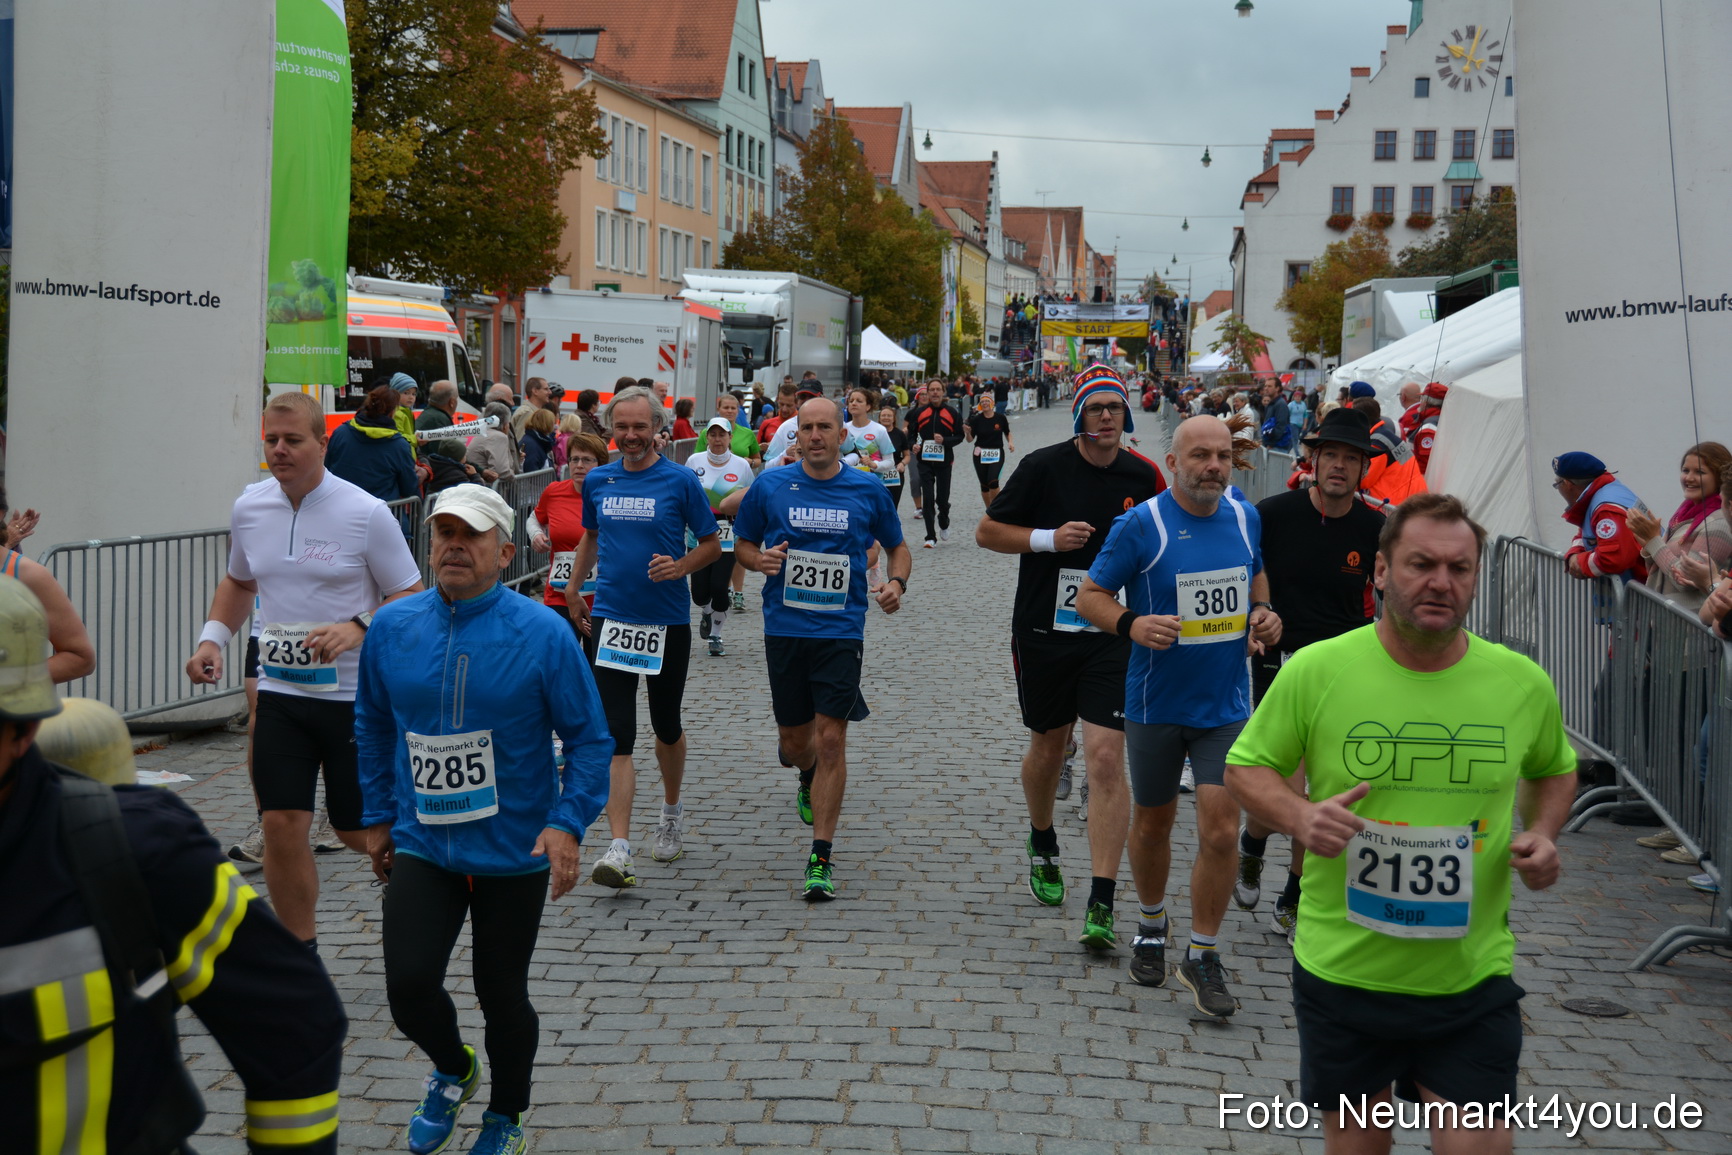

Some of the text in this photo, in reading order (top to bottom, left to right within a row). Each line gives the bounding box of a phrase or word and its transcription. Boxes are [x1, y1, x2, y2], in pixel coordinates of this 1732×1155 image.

[15, 278, 220, 308] www.bmw-laufsport.de
[1075, 325, 1112, 334] START
[593, 334, 644, 344] Bayerisches
[593, 345, 617, 353] Rotes
[592, 355, 617, 363] Kreuz
[863, 359, 897, 367] Laufsport
[427, 426, 480, 439] bmw-laufsport.de
[924, 445, 943, 454] 2563
[602, 496, 656, 510] HUBER
[788, 507, 849, 523] HUBER
[802, 521, 846, 529] TECHNOLOGY
[297, 541, 341, 566] Julia
[788, 555, 840, 566] PARTL Neumarkt
[791, 564, 844, 590] 2318
[1060, 574, 1083, 582] PARTL
[1178, 575, 1238, 588] PARTL Neumarkt
[796, 591, 834, 603] Willibald
[1194, 586, 1238, 616] 380
[1202, 621, 1233, 633] Martin
[607, 627, 660, 653] 2566
[266, 640, 325, 665] 233
[610, 652, 649, 668] Wolfgang
[280, 671, 316, 682] Manuel
[427, 741, 474, 753] Neumarkt
[1343, 721, 1506, 784] OPF
[412, 752, 486, 790] 2285
[1392, 785, 1480, 794] Automatisierungstechnik
[424, 796, 471, 812] Helmut
[1391, 837, 1451, 848] Neumarkt
[1357, 847, 1461, 896] 2133
[1384, 903, 1425, 925] Sepp
